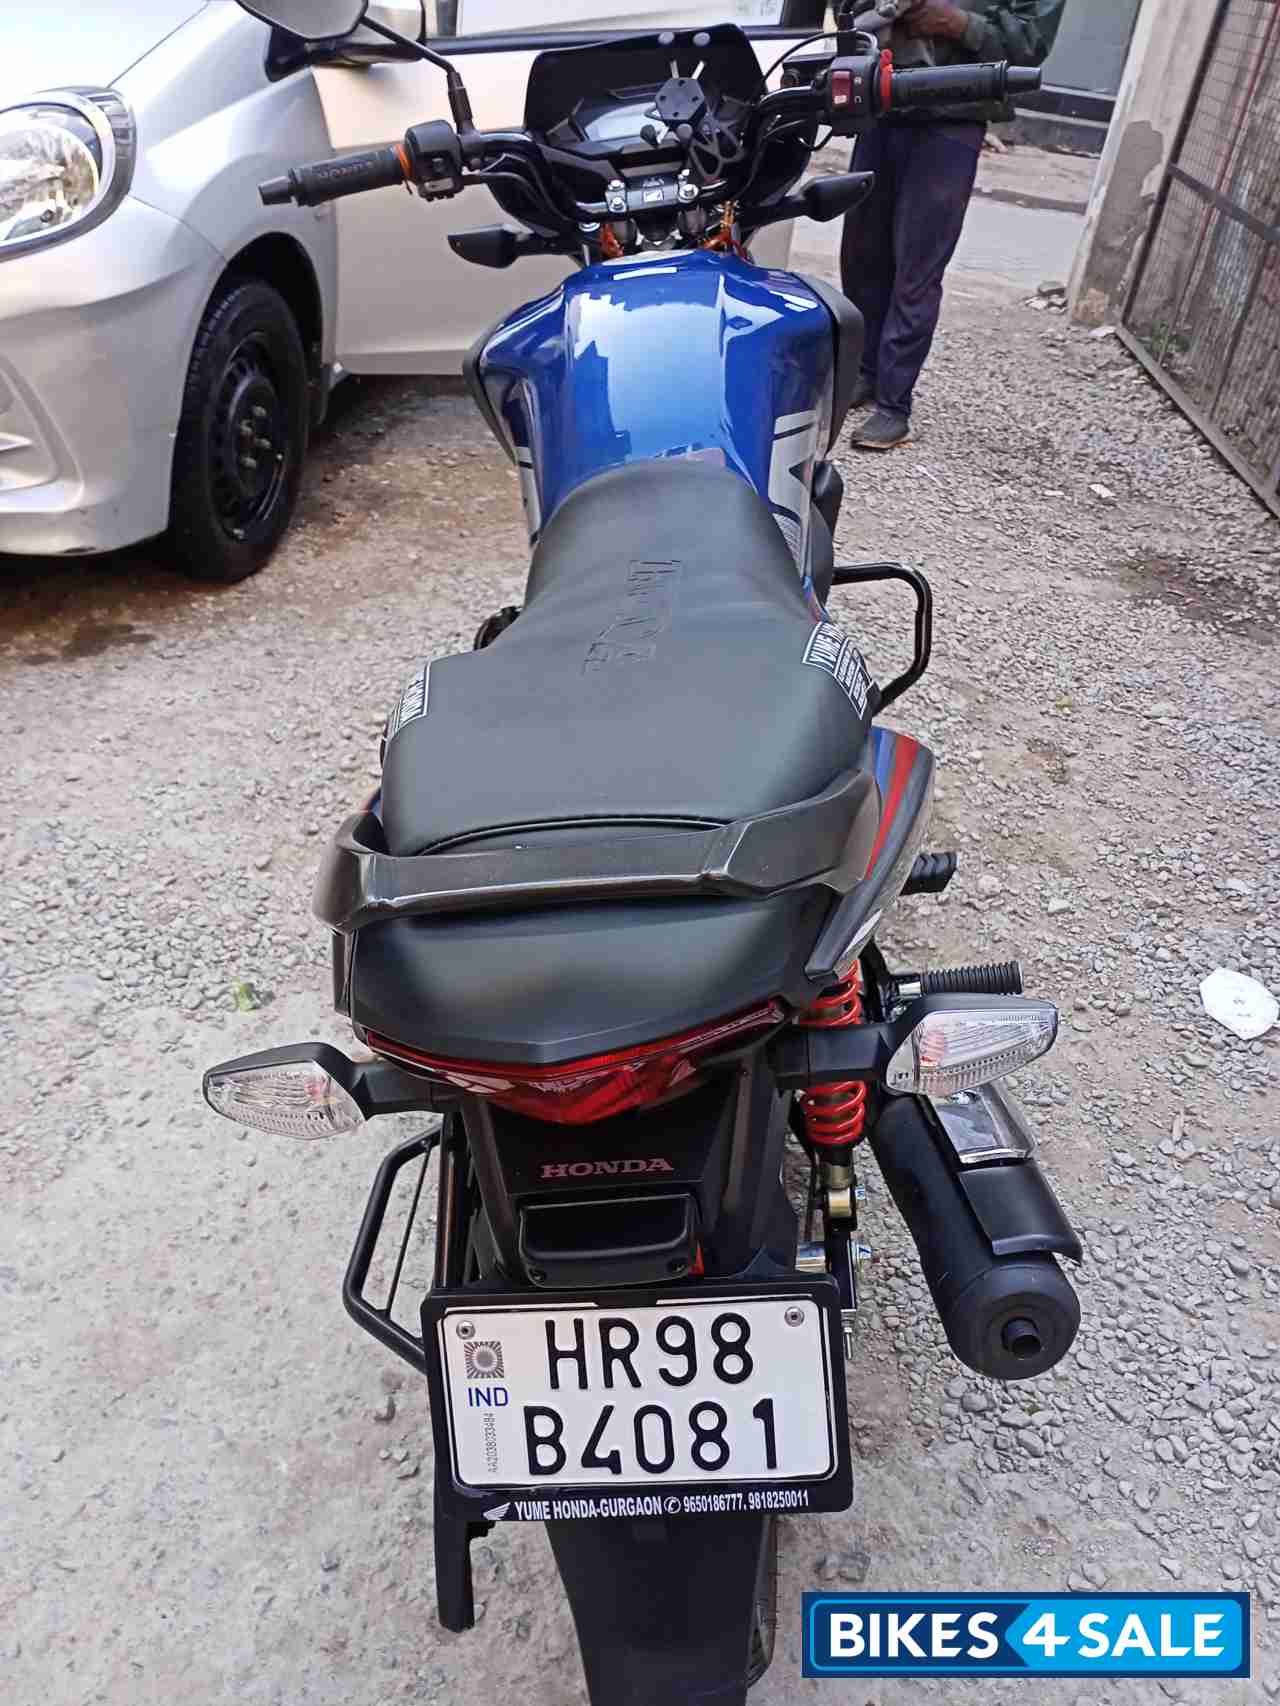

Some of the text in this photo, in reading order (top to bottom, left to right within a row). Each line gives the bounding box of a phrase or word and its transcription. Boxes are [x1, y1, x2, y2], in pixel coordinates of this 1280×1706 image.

[541, 1158, 674, 1178] HONDA
[545, 1312, 754, 1390] HR98
[468, 1387, 509, 1407] IND
[523, 1398, 778, 1476] B4081
[514, 1501, 551, 1520] YUME
[552, 1496, 663, 1519] HONDA-GURGAON
[749, 1489, 809, 1509] 9818250011
